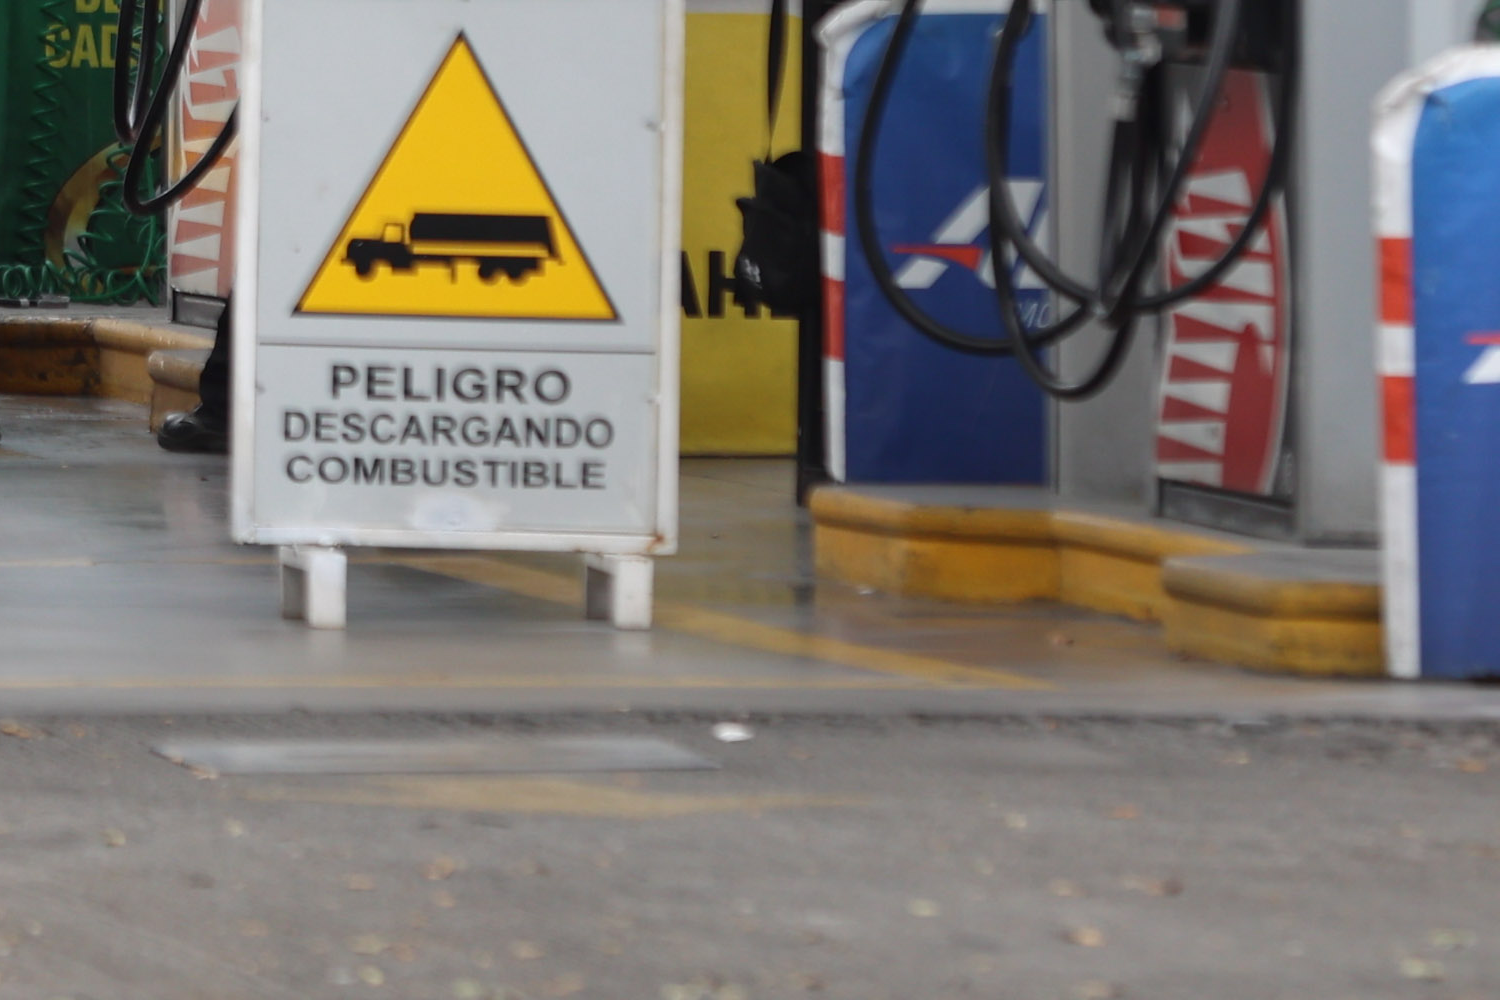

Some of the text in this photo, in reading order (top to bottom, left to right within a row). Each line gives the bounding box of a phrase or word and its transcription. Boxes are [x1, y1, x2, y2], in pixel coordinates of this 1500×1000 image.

[330, 364, 573, 405] PELIGRO
[283, 411, 616, 449] DESCARGANDO
[285, 455, 608, 490] COMBUSTIBLE
